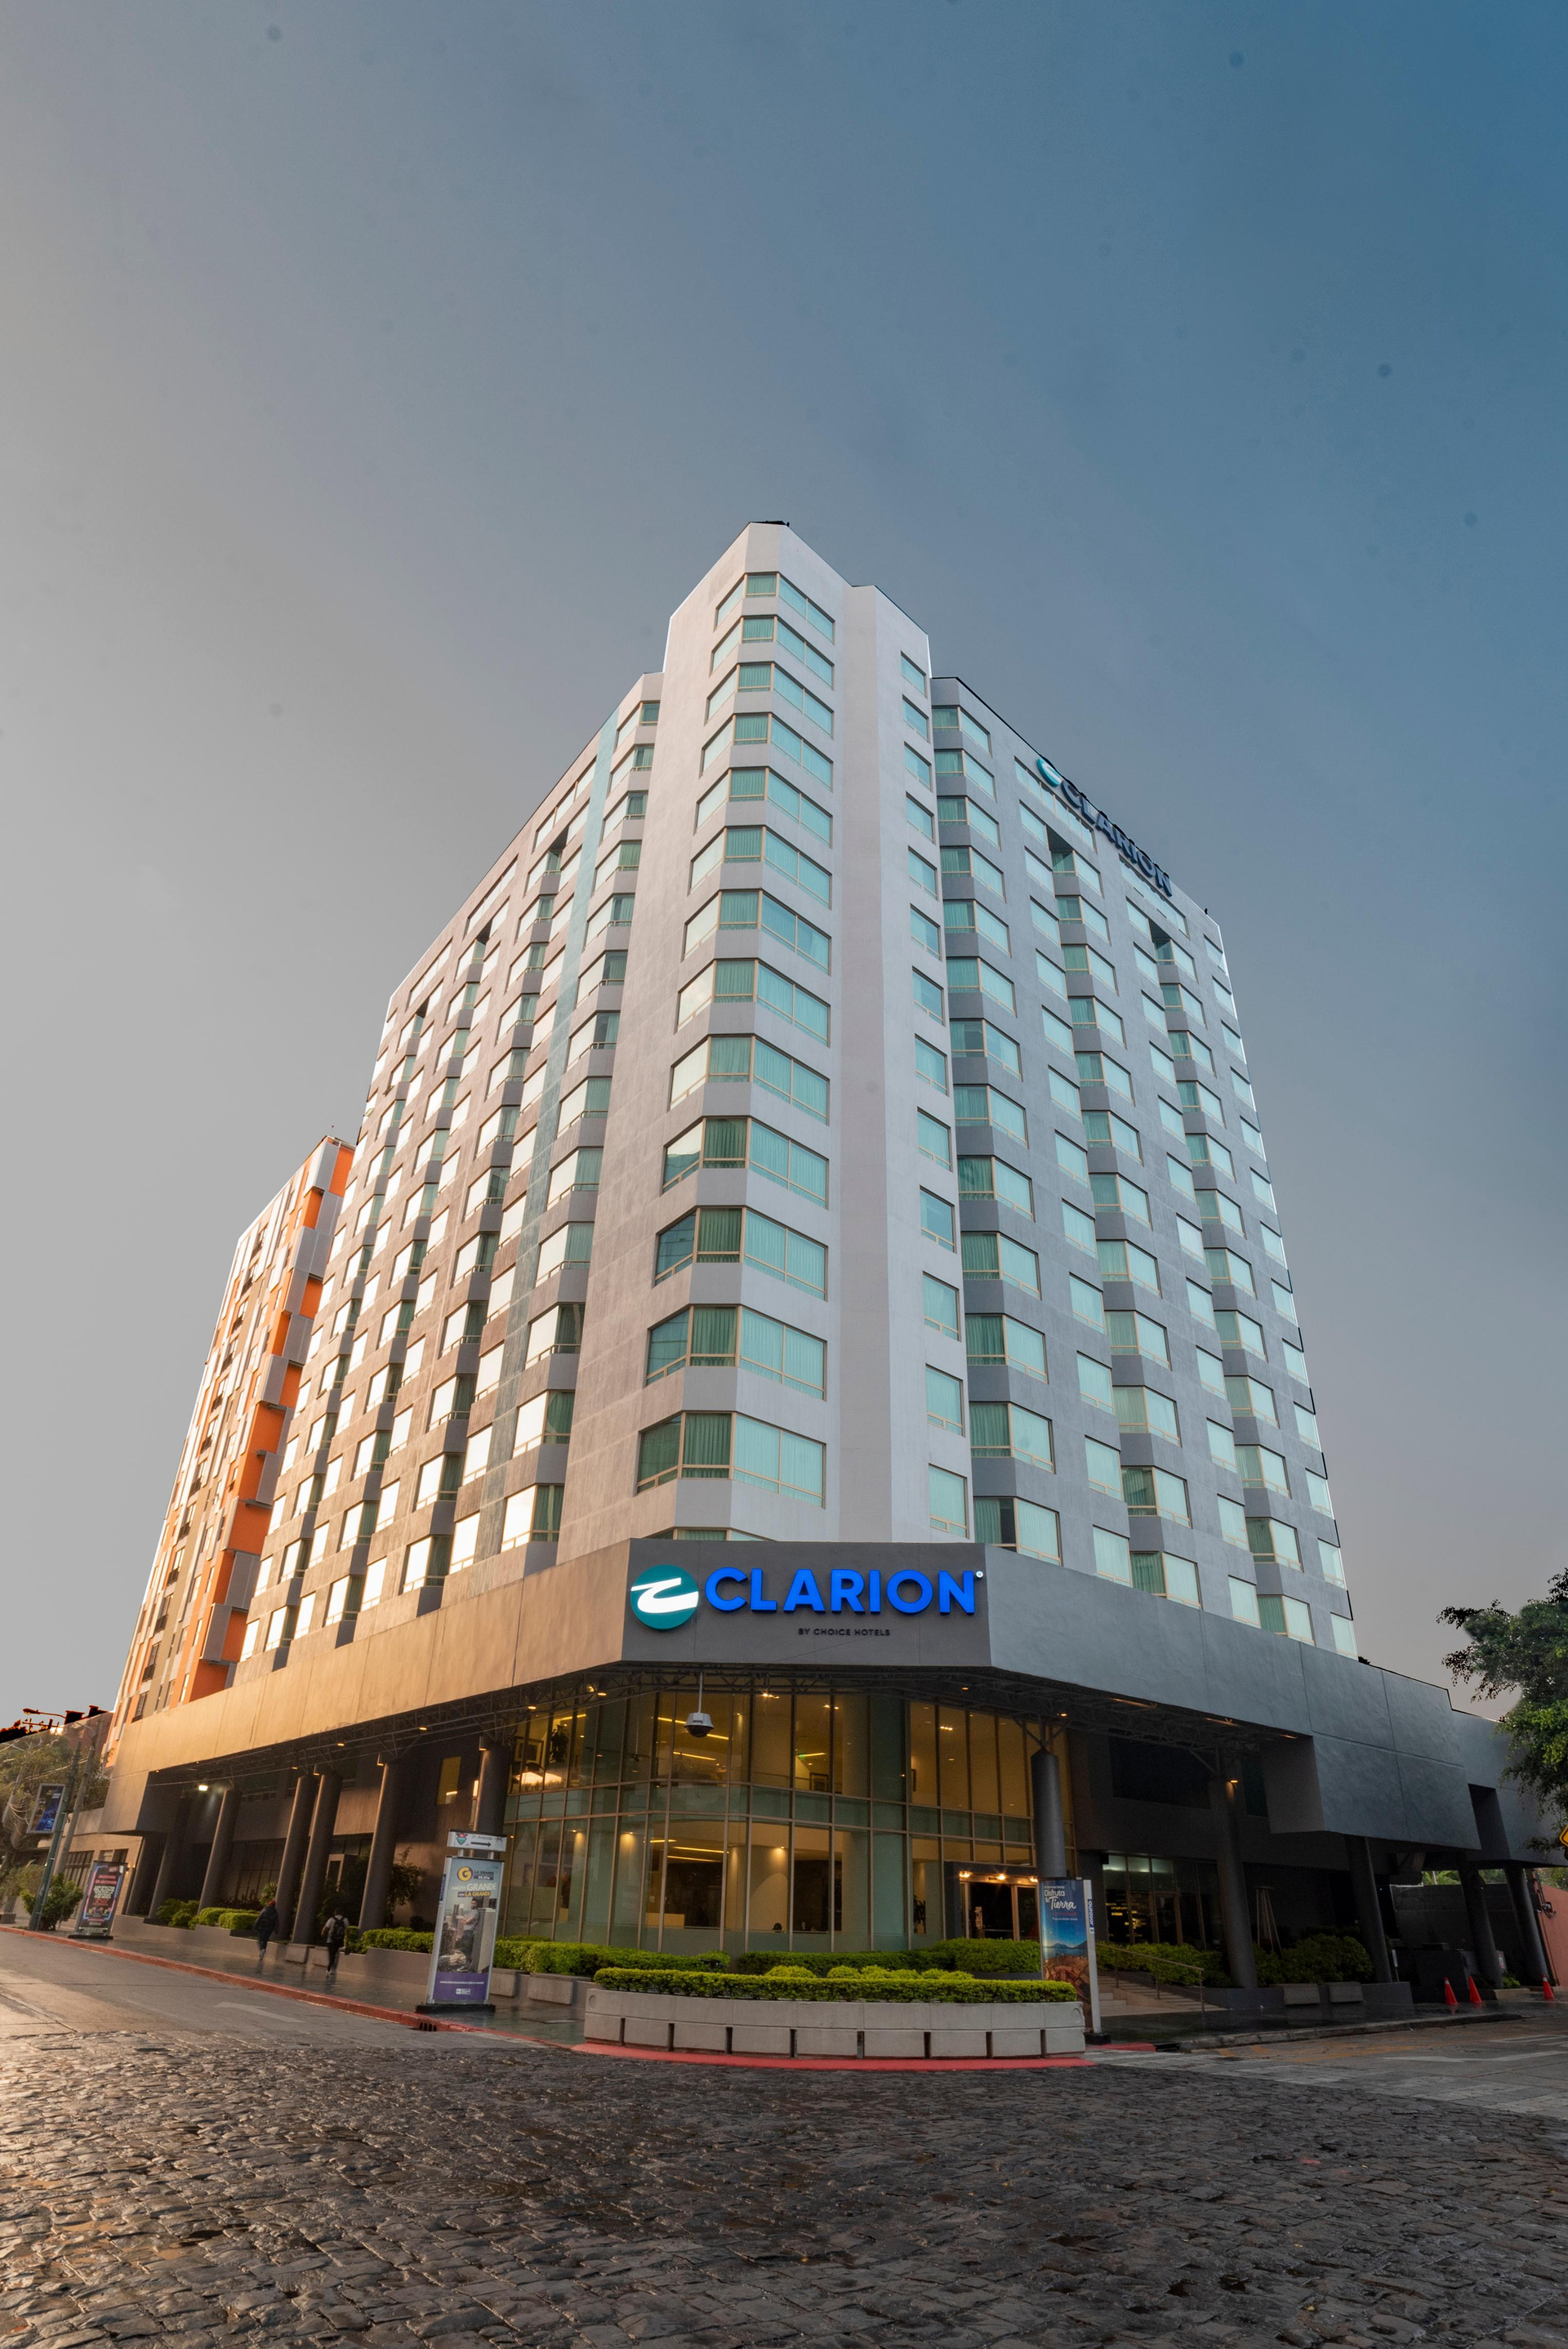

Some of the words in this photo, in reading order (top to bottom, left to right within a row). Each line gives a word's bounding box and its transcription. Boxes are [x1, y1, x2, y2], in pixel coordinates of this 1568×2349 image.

[1062, 778, 1172, 897] CLARION
[705, 1567, 976, 1615] CLARION
[813, 1628, 851, 1636] CHOICE
[466, 1883, 497, 1891] GRANDE
[1049, 1896, 1076, 1910] Tierra
